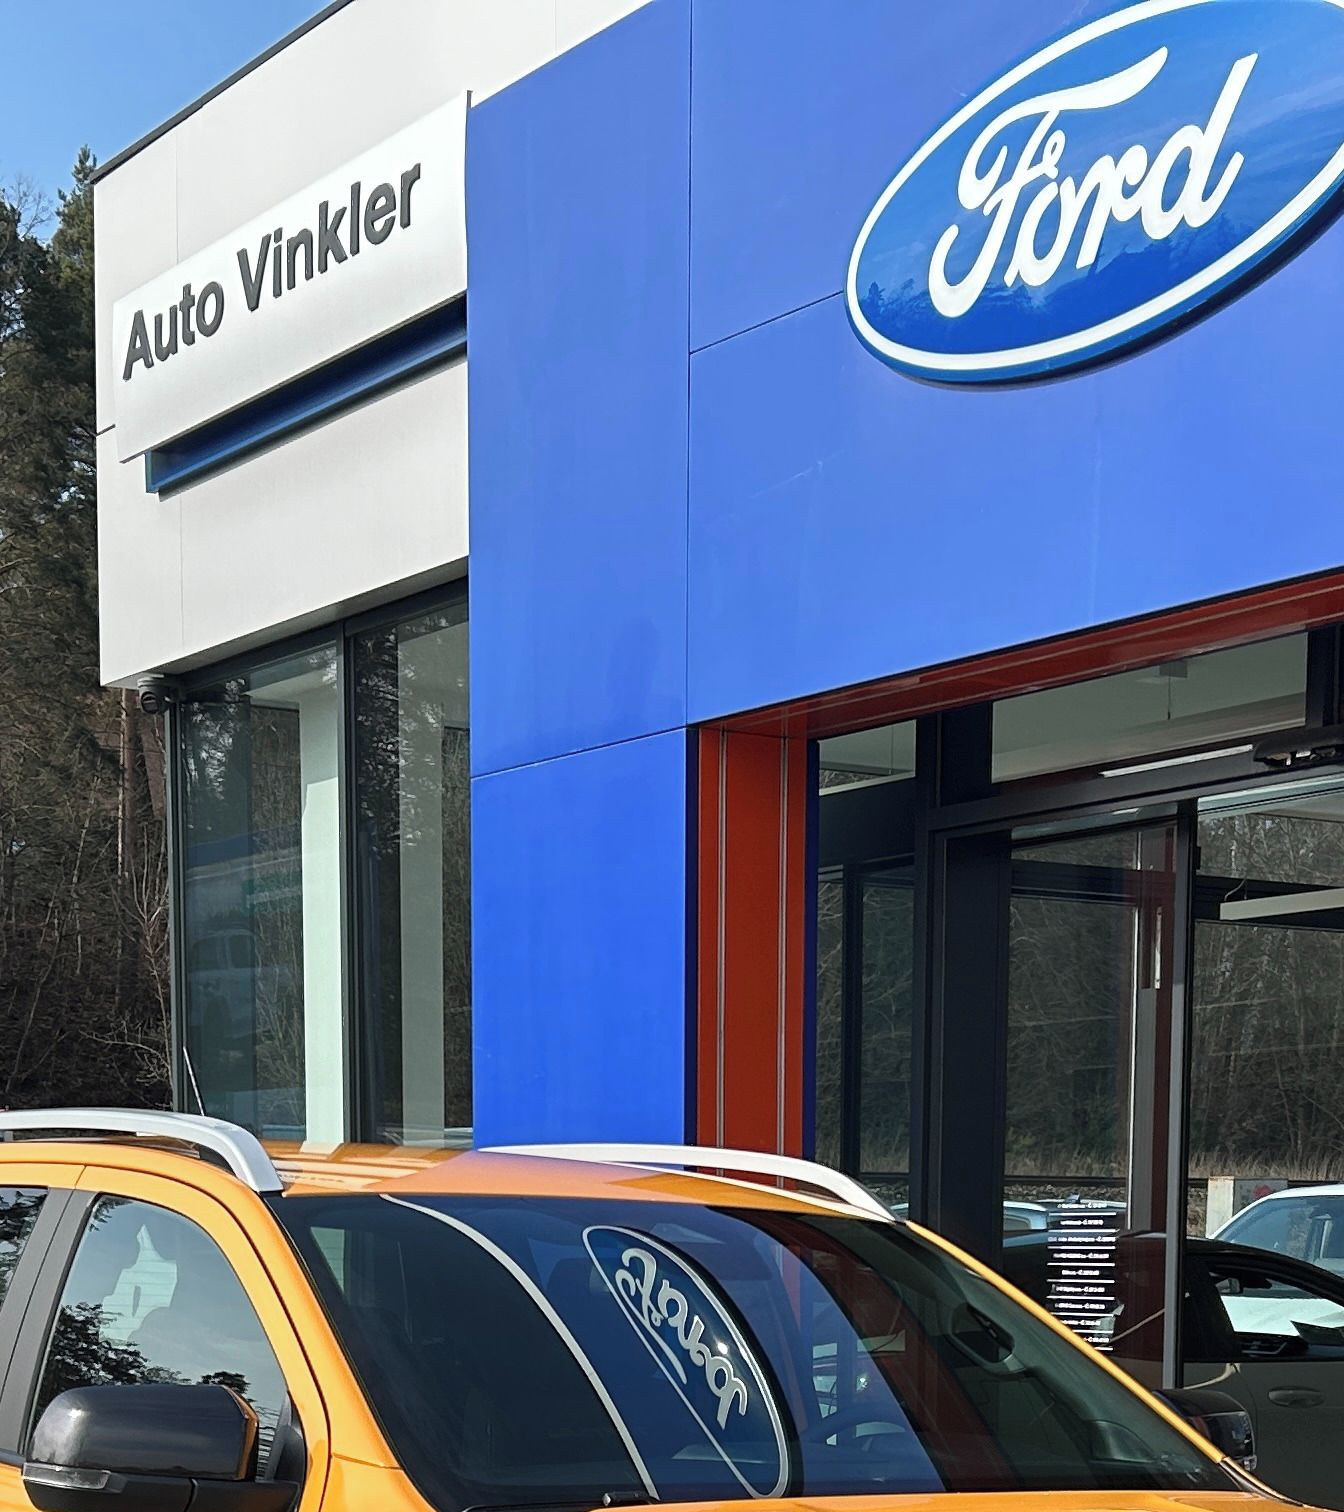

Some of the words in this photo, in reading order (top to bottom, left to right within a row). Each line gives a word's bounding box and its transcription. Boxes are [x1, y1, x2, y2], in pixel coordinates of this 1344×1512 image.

[122, 281, 225, 382] Auto
[236, 163, 421, 313] Vinkler
[928, 45, 1259, 319] Ford
